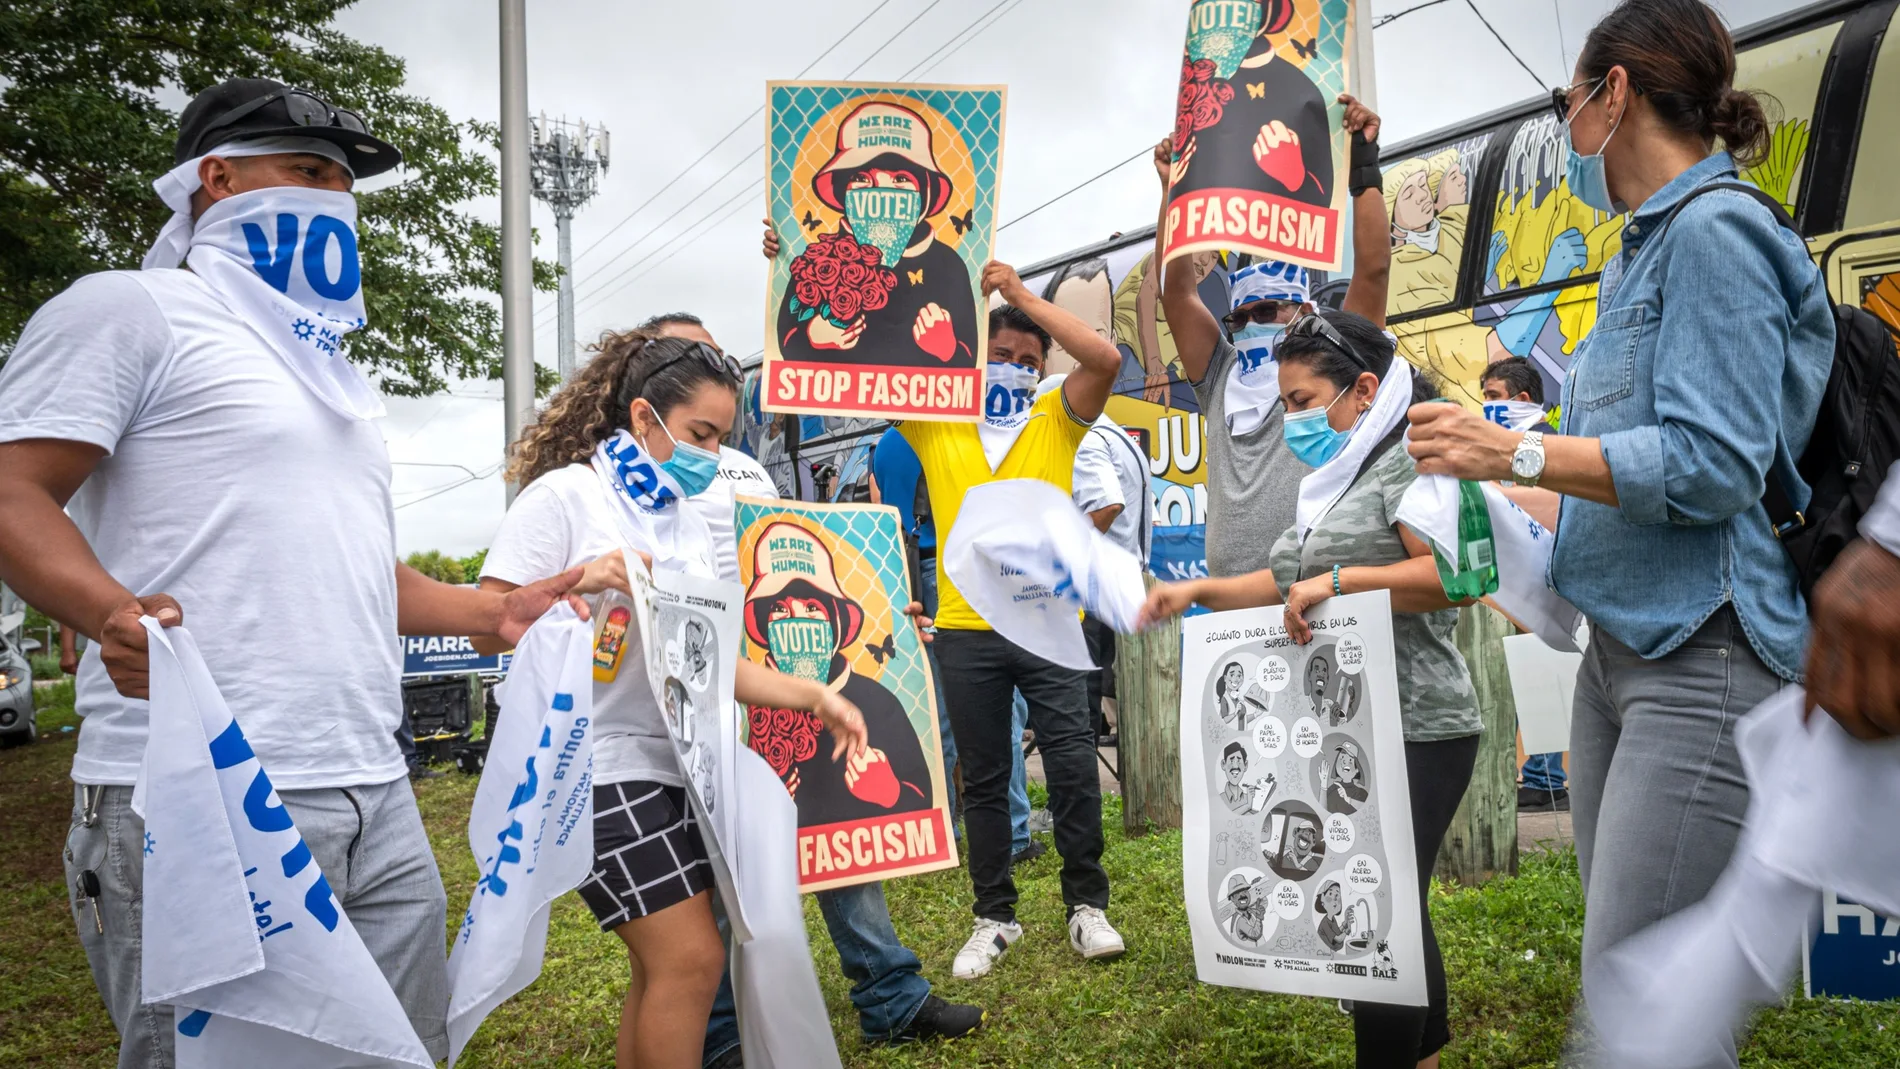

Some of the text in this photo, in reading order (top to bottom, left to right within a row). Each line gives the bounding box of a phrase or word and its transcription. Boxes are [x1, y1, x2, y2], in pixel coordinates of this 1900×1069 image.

[1190, 1, 1253, 35] VOTE!
[859, 116, 912, 130] WE ARE
[858, 136, 911, 150] HUMAN
[853, 191, 912, 220] VOTE!
[1187, 196, 1326, 254] FASCISM
[315, 338, 336, 357] TPS
[778, 368, 974, 409] STOP FASCISM
[769, 538, 814, 553] WE ARE
[772, 560, 815, 575] HUMAN
[1244, 627, 1266, 638] DURA
[1269, 625, 1277, 636] EL
[1330, 618, 1341, 629] EN
[1343, 616, 1358, 627] LAS
[775, 622, 826, 654] VOTE!
[424, 653, 480, 663] JOEBIDEN.COM
[1337, 833, 1350, 842] DÍAS
[799, 818, 937, 877] FASCISM
[1285, 899, 1299, 907] DÍAS
[1222, 956, 1244, 966] NDLON
[1335, 965, 1366, 975] CARECEN
[1372, 970, 1397, 980] DALE
